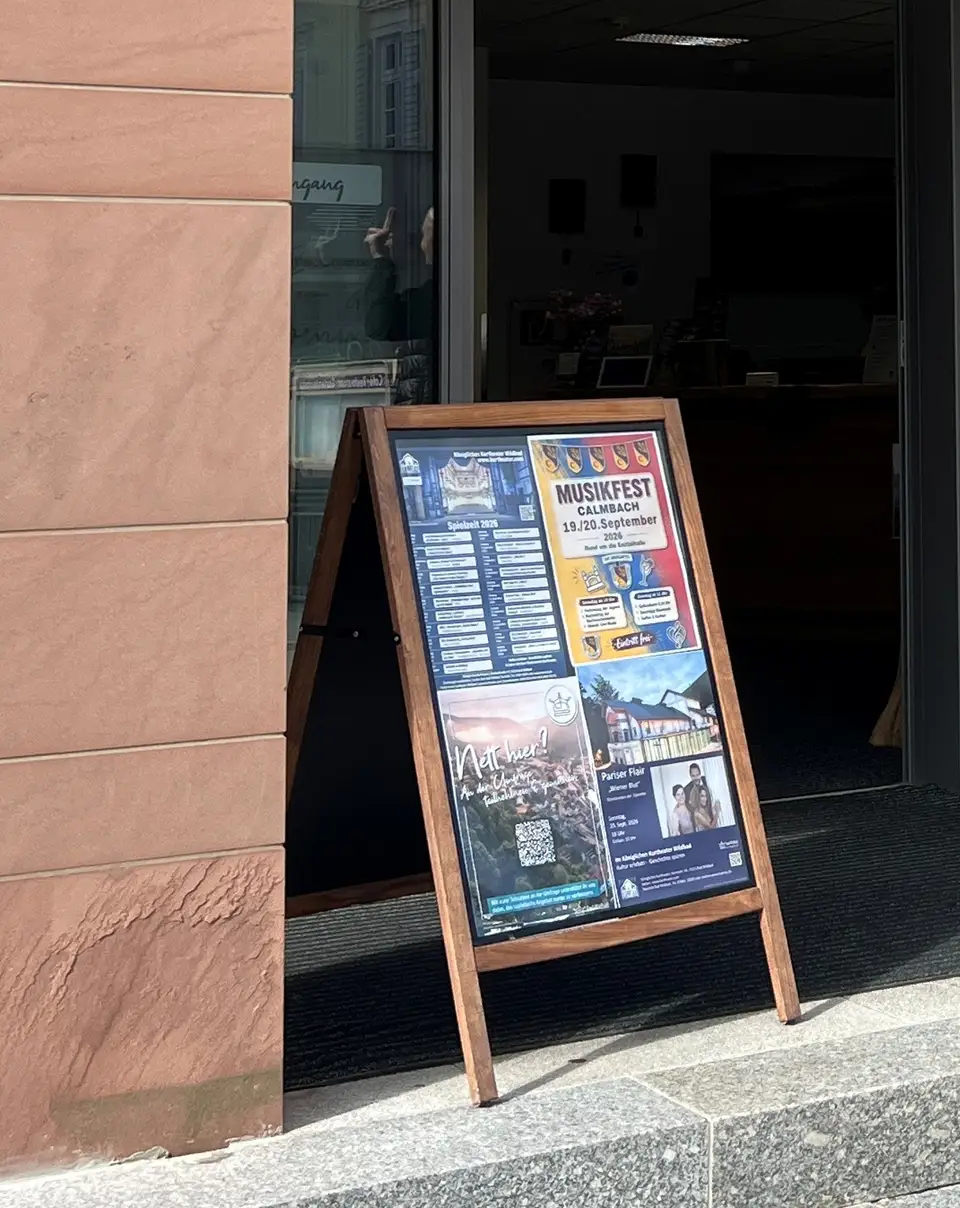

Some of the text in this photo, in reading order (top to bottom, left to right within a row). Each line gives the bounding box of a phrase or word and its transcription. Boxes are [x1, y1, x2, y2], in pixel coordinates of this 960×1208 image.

[292, 178, 345, 202] ngang
[555, 478, 652, 505] MUSIKFEST
[577, 501, 640, 516] CALMBACH
[447, 519, 499, 532] Spielzeit 2026
[603, 532, 623, 542] 2026
[454, 743, 501, 781] Nett
[601, 766, 646, 781] Pariser Flair
